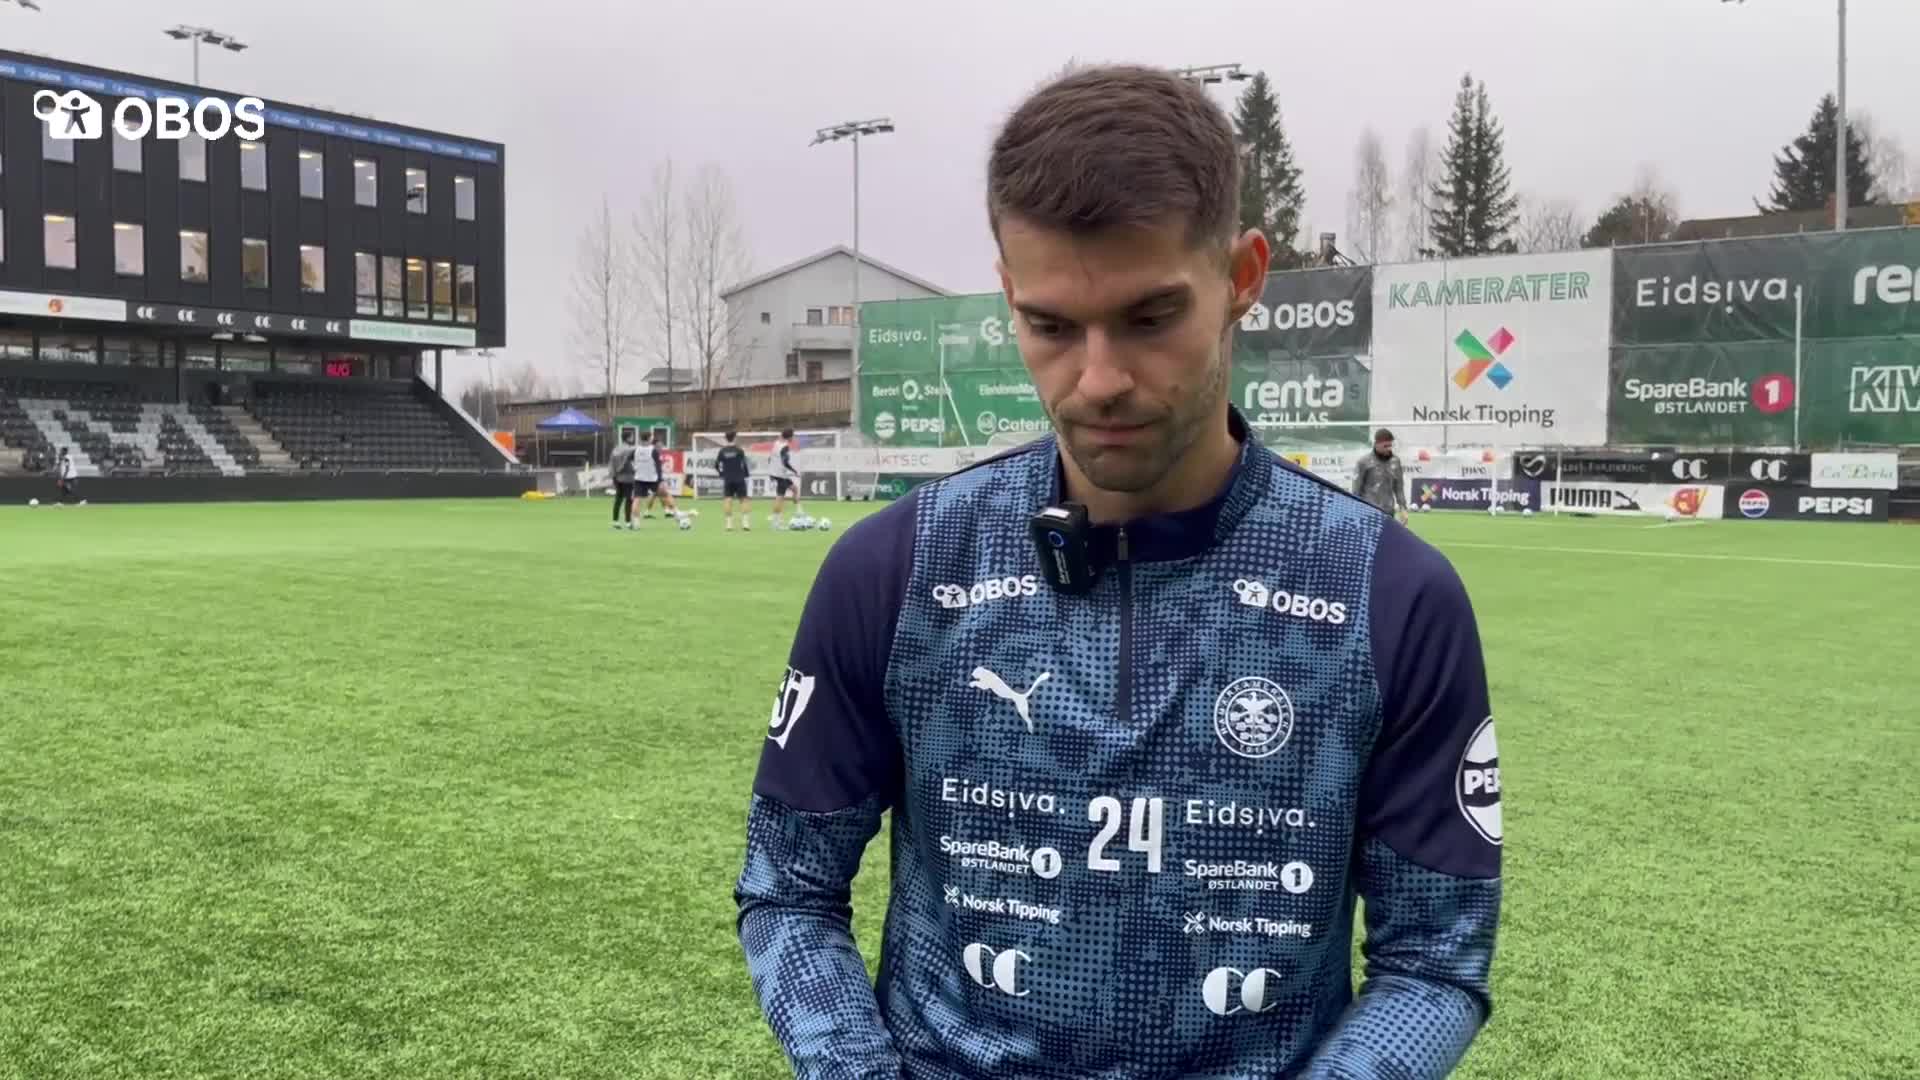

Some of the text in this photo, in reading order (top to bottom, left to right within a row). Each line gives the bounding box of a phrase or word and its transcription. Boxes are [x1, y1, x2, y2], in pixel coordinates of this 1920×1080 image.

[1388, 271, 1591, 309] KAMERATER
[1274, 299, 1355, 330] OBOS
[1244, 373, 1344, 409] renta
[1624, 377, 1747, 403] SpareBank
[1413, 404, 1555, 429] Norsk Tipping
[1654, 400, 1748, 414] ØSTLANDET
[1257, 411, 1329, 430] STILLAS
[1442, 487, 1480, 502] Norsk
[1550, 487, 1612, 508] PUMA
[1798, 496, 1873, 515] PEPSI
[969, 574, 1038, 606] OBOS
[1272, 589, 1347, 625] OBOS
[1087, 795, 1163, 873] 24
[940, 835, 1030, 862] SpareBank
[960, 857, 1030, 875] ØSTLANDET
[1184, 858, 1279, 879] SpareBank
[1208, 879, 1279, 891] ØSTLANDET
[963, 893, 1060, 925] Norsk Tipping
[1209, 917, 1312, 939] Norsk Tipping
